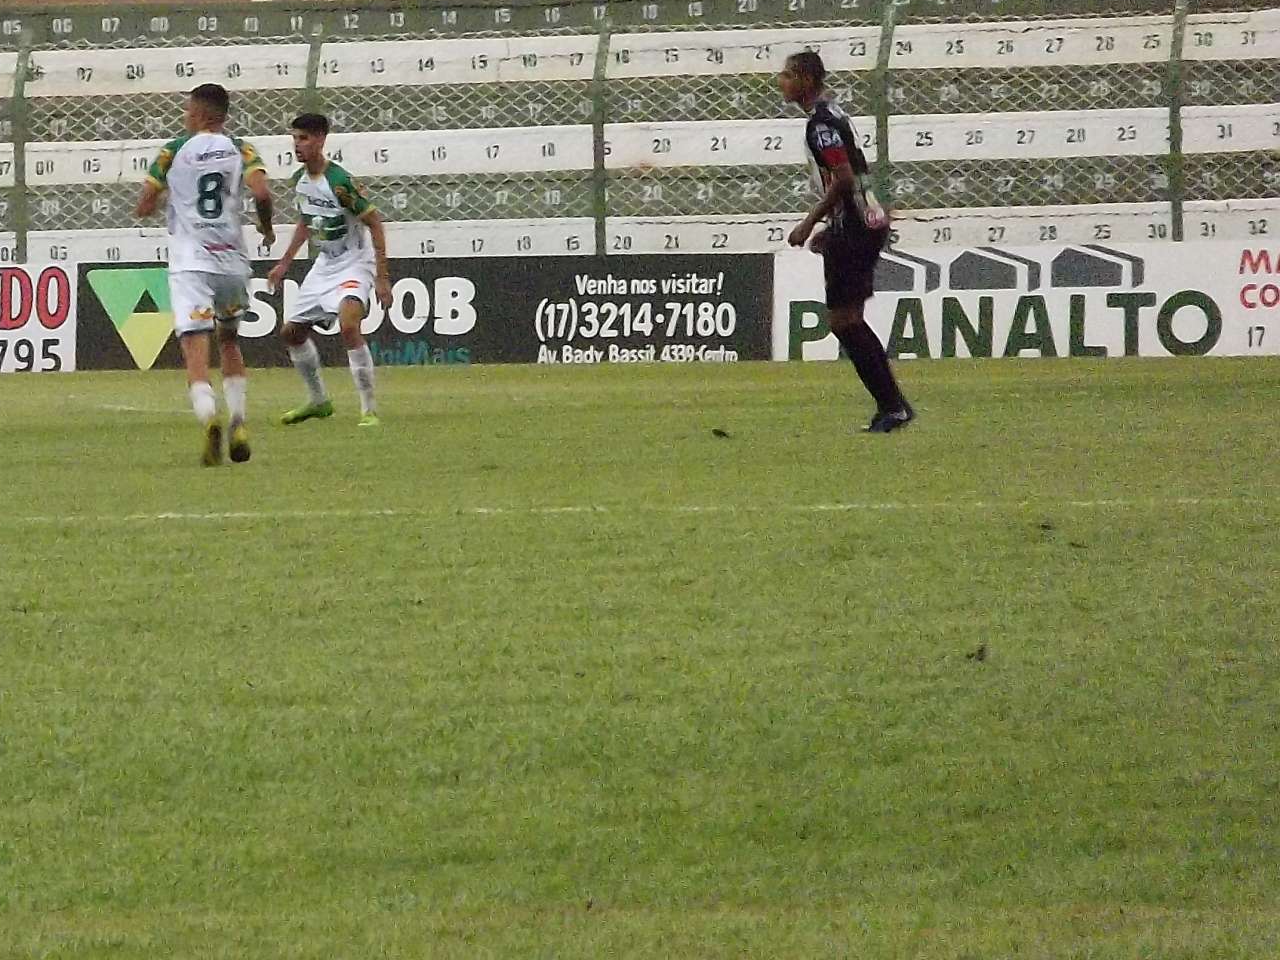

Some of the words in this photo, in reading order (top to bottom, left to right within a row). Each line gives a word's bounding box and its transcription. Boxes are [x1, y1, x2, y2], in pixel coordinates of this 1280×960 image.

[197, 171, 223, 219] 8
[471, 238, 484, 253] 17
[664, 234, 680, 250] 21
[711, 233, 729, 249] 22
[767, 226, 786, 242] 23
[575, 274, 627, 295] Venha
[630, 279, 657, 295] nos
[661, 271, 724, 295] visitar!
[788, 289, 1222, 360] PANALTO
[1247, 326, 1266, 348] 17
